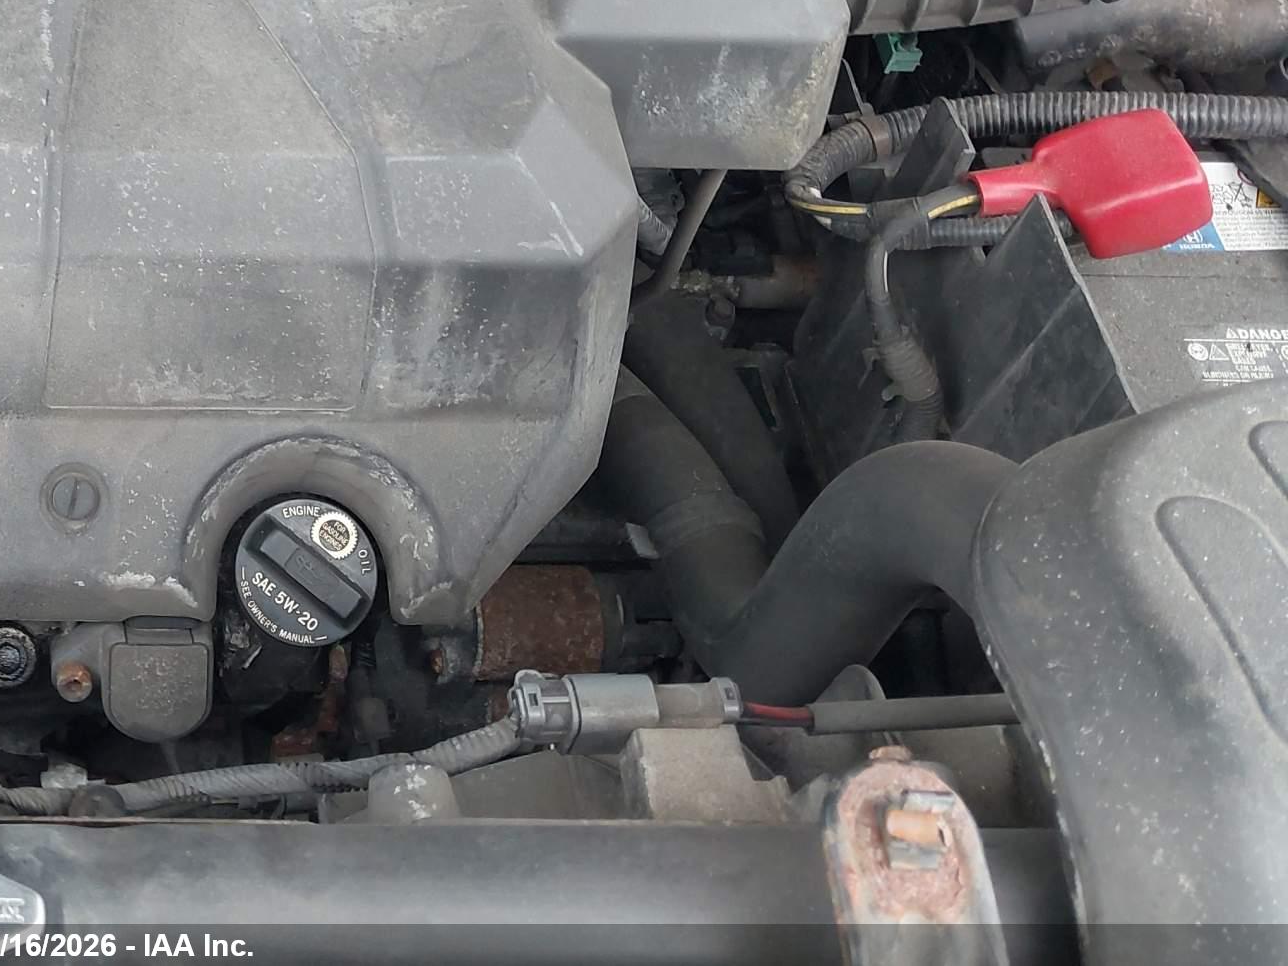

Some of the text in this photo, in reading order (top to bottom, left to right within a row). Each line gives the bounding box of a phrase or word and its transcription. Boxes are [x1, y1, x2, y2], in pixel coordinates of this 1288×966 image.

[282, 505, 372, 575] ENGINE OIL
[322, 522, 349, 546] GASOLINE
[333, 521, 346, 533] FOR
[240, 580, 315, 643] SEE OWNER'S MANUAL
[251, 571, 319, 631] SAE 5W-20
